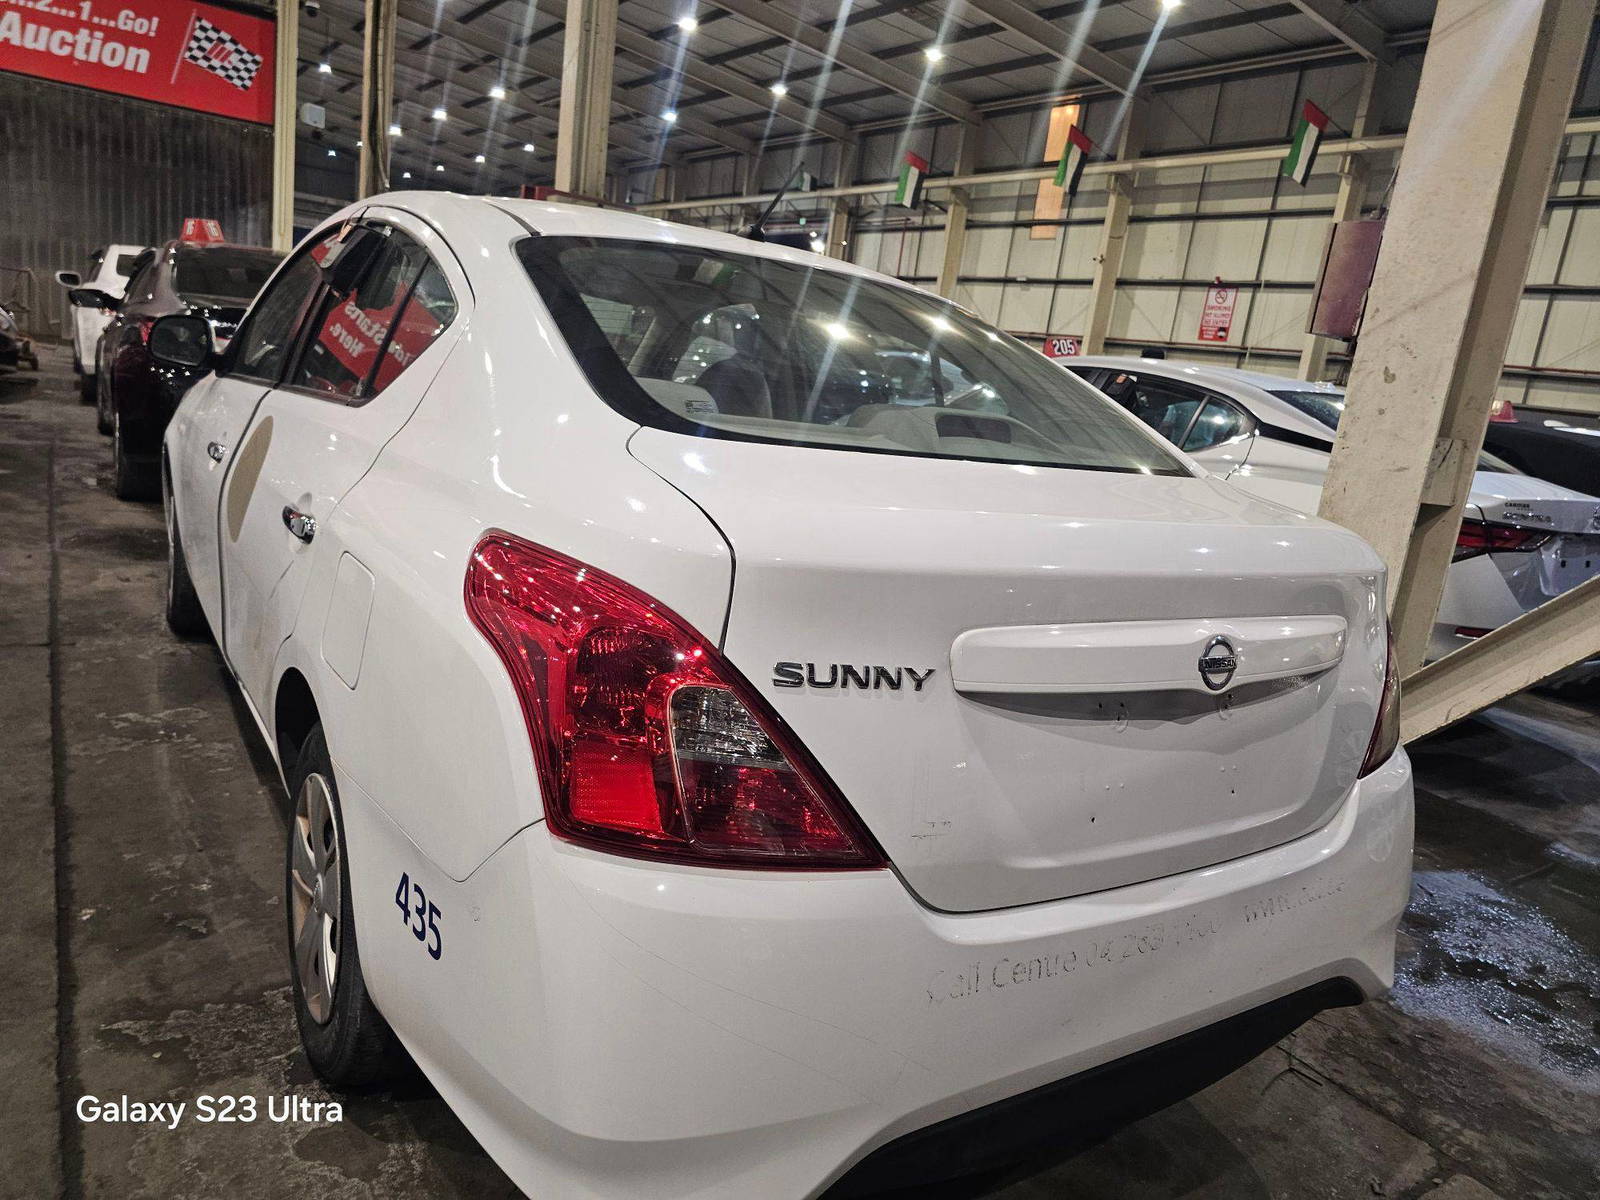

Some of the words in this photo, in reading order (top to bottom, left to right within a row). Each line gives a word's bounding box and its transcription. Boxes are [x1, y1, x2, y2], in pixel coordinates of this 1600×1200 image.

[0, 11, 150, 73] Auction
[1052, 339, 1075, 356] 205
[772, 661, 937, 691] SUNNY
[395, 871, 442, 960] 435
